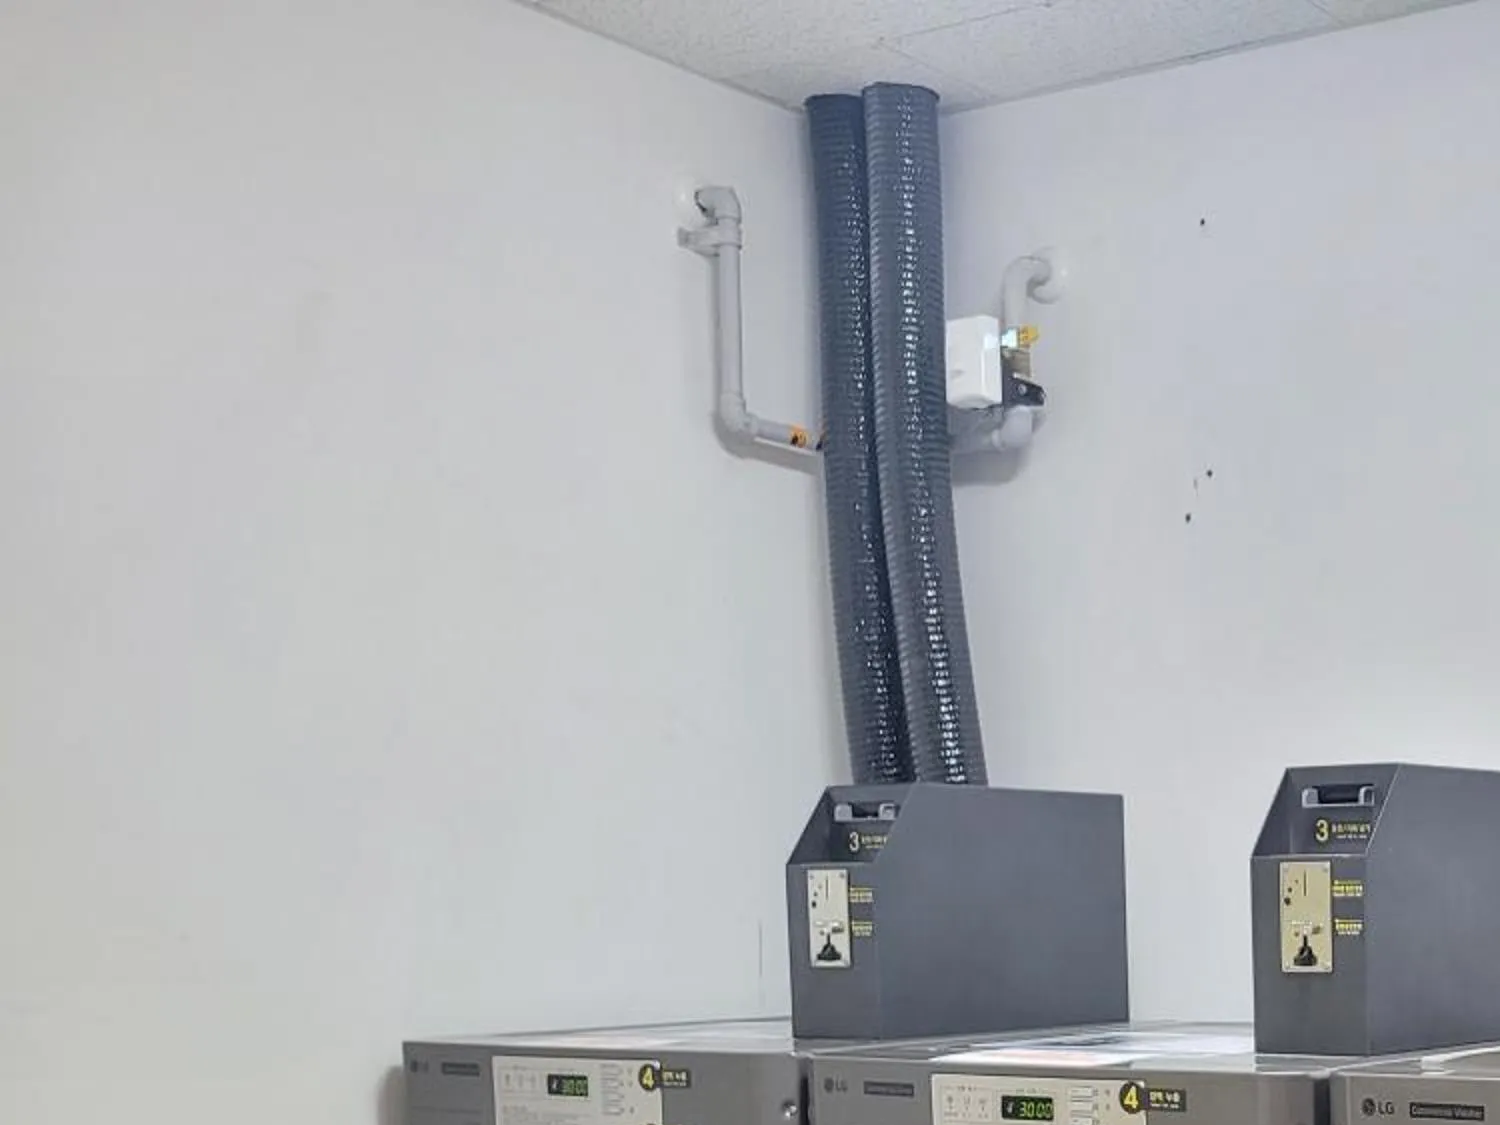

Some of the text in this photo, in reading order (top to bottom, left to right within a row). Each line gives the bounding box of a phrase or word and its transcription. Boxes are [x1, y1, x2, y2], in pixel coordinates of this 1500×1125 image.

[1316, 819, 1328, 841] 3
[850, 831, 859, 851] 3
[642, 1067, 654, 1088] 4
[1124, 1085, 1139, 1109] 4
[1378, 1101, 1395, 1115] LG
